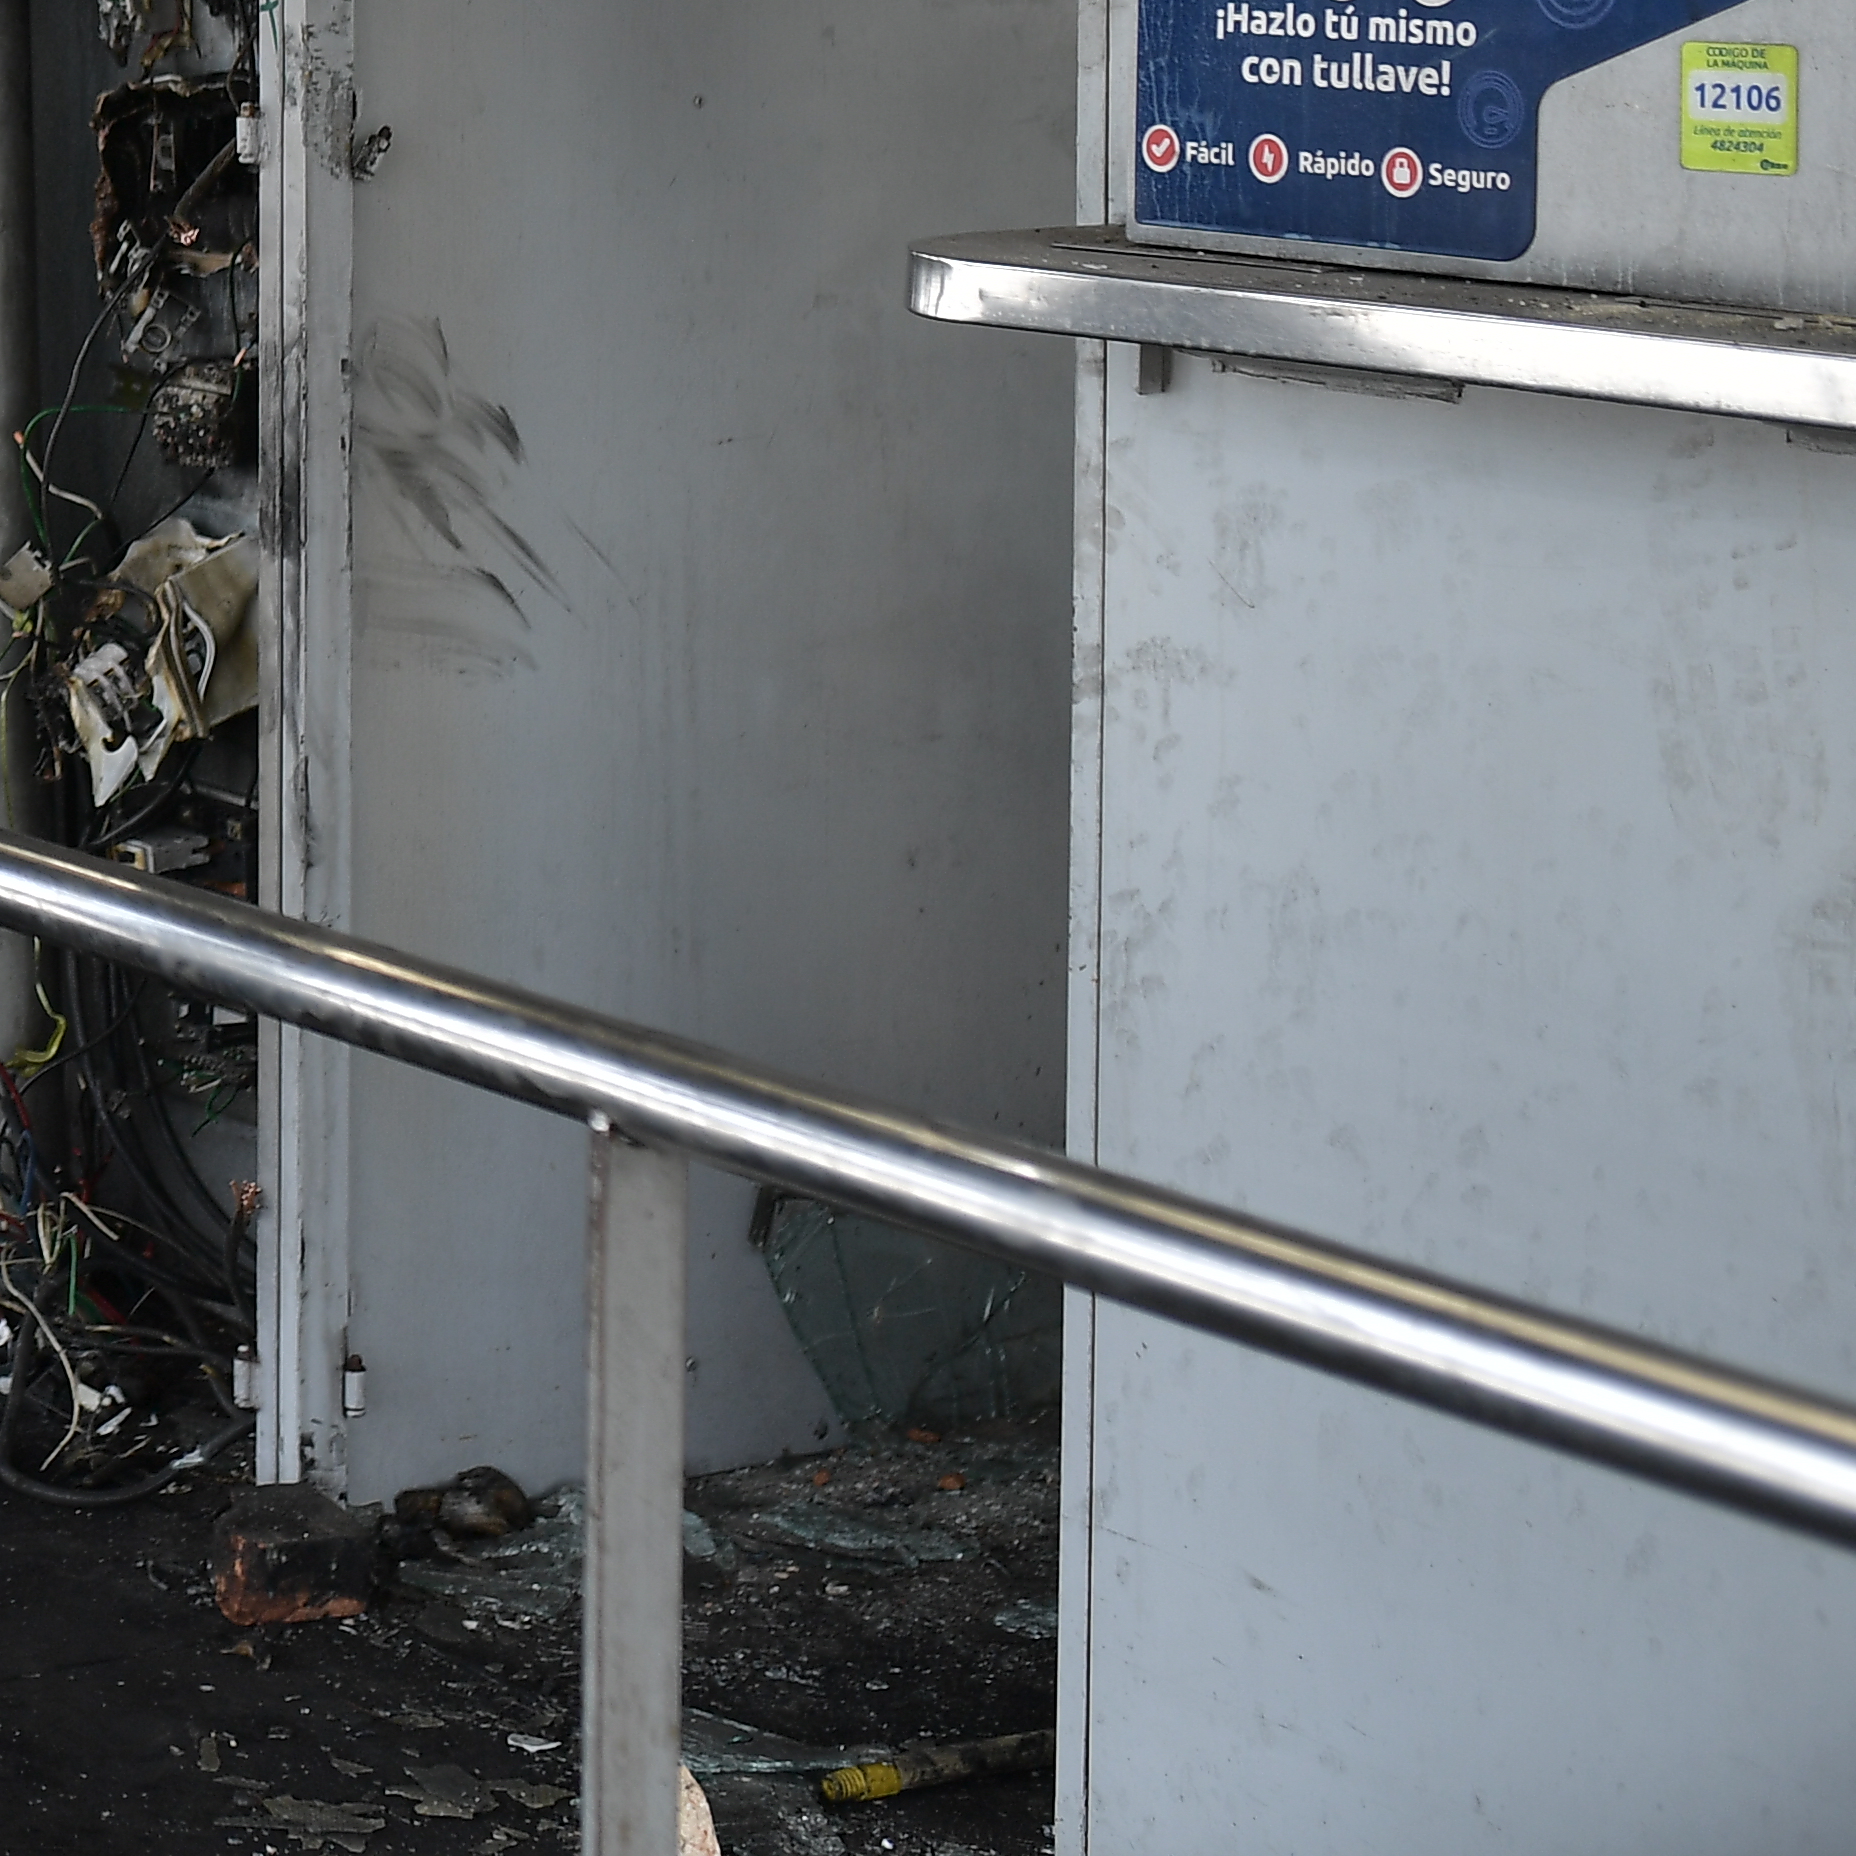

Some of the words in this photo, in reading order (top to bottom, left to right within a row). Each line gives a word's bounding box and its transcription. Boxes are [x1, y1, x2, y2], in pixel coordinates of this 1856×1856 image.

[1216, 2, 1316, 41] ¡Hazlo
[1324, 4, 1359, 41] tú
[1368, 8, 1477, 48] mismo
[1706, 59, 1720, 68] LA
[1751, 48, 1767, 59] DE
[1240, 54, 1303, 87] con
[1312, 52, 1452, 97] tullave!
[1694, 83, 1782, 113] 12106
[1185, 140, 1235, 167] Fácil
[1298, 150, 1375, 180] Rápido
[1428, 163, 1512, 194] Seguro
